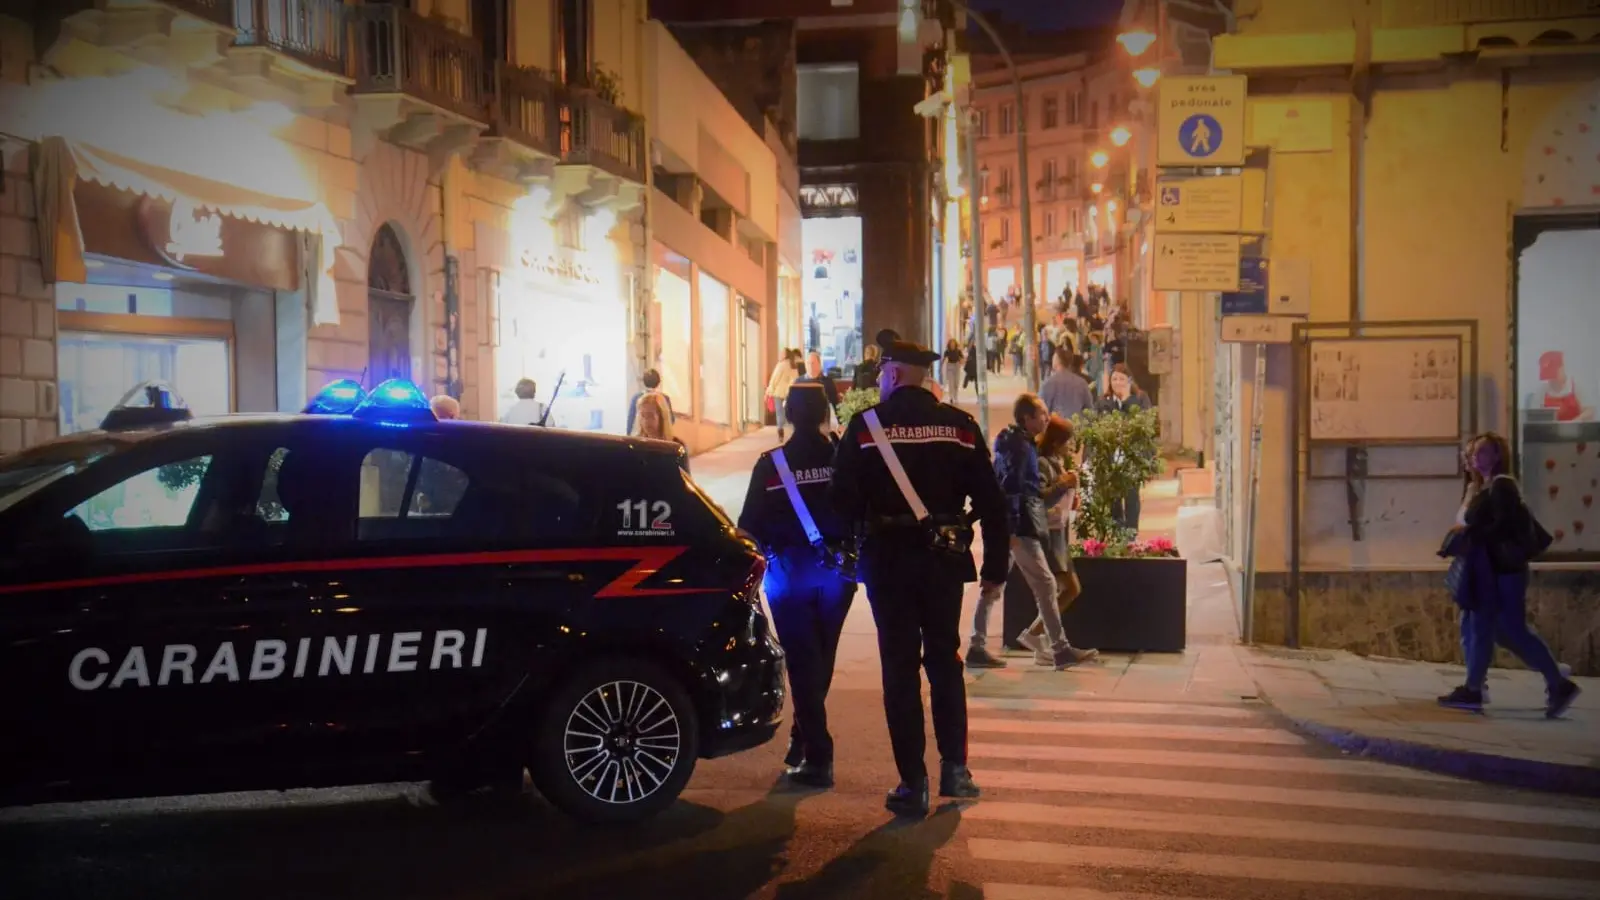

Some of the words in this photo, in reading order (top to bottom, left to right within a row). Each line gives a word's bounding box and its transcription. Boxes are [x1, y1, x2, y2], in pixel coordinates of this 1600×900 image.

[1187, 84, 1217, 93] area
[1170, 97, 1232, 108] pedonale
[616, 498, 672, 530] 112
[68, 627, 488, 691] CARABINIERI
